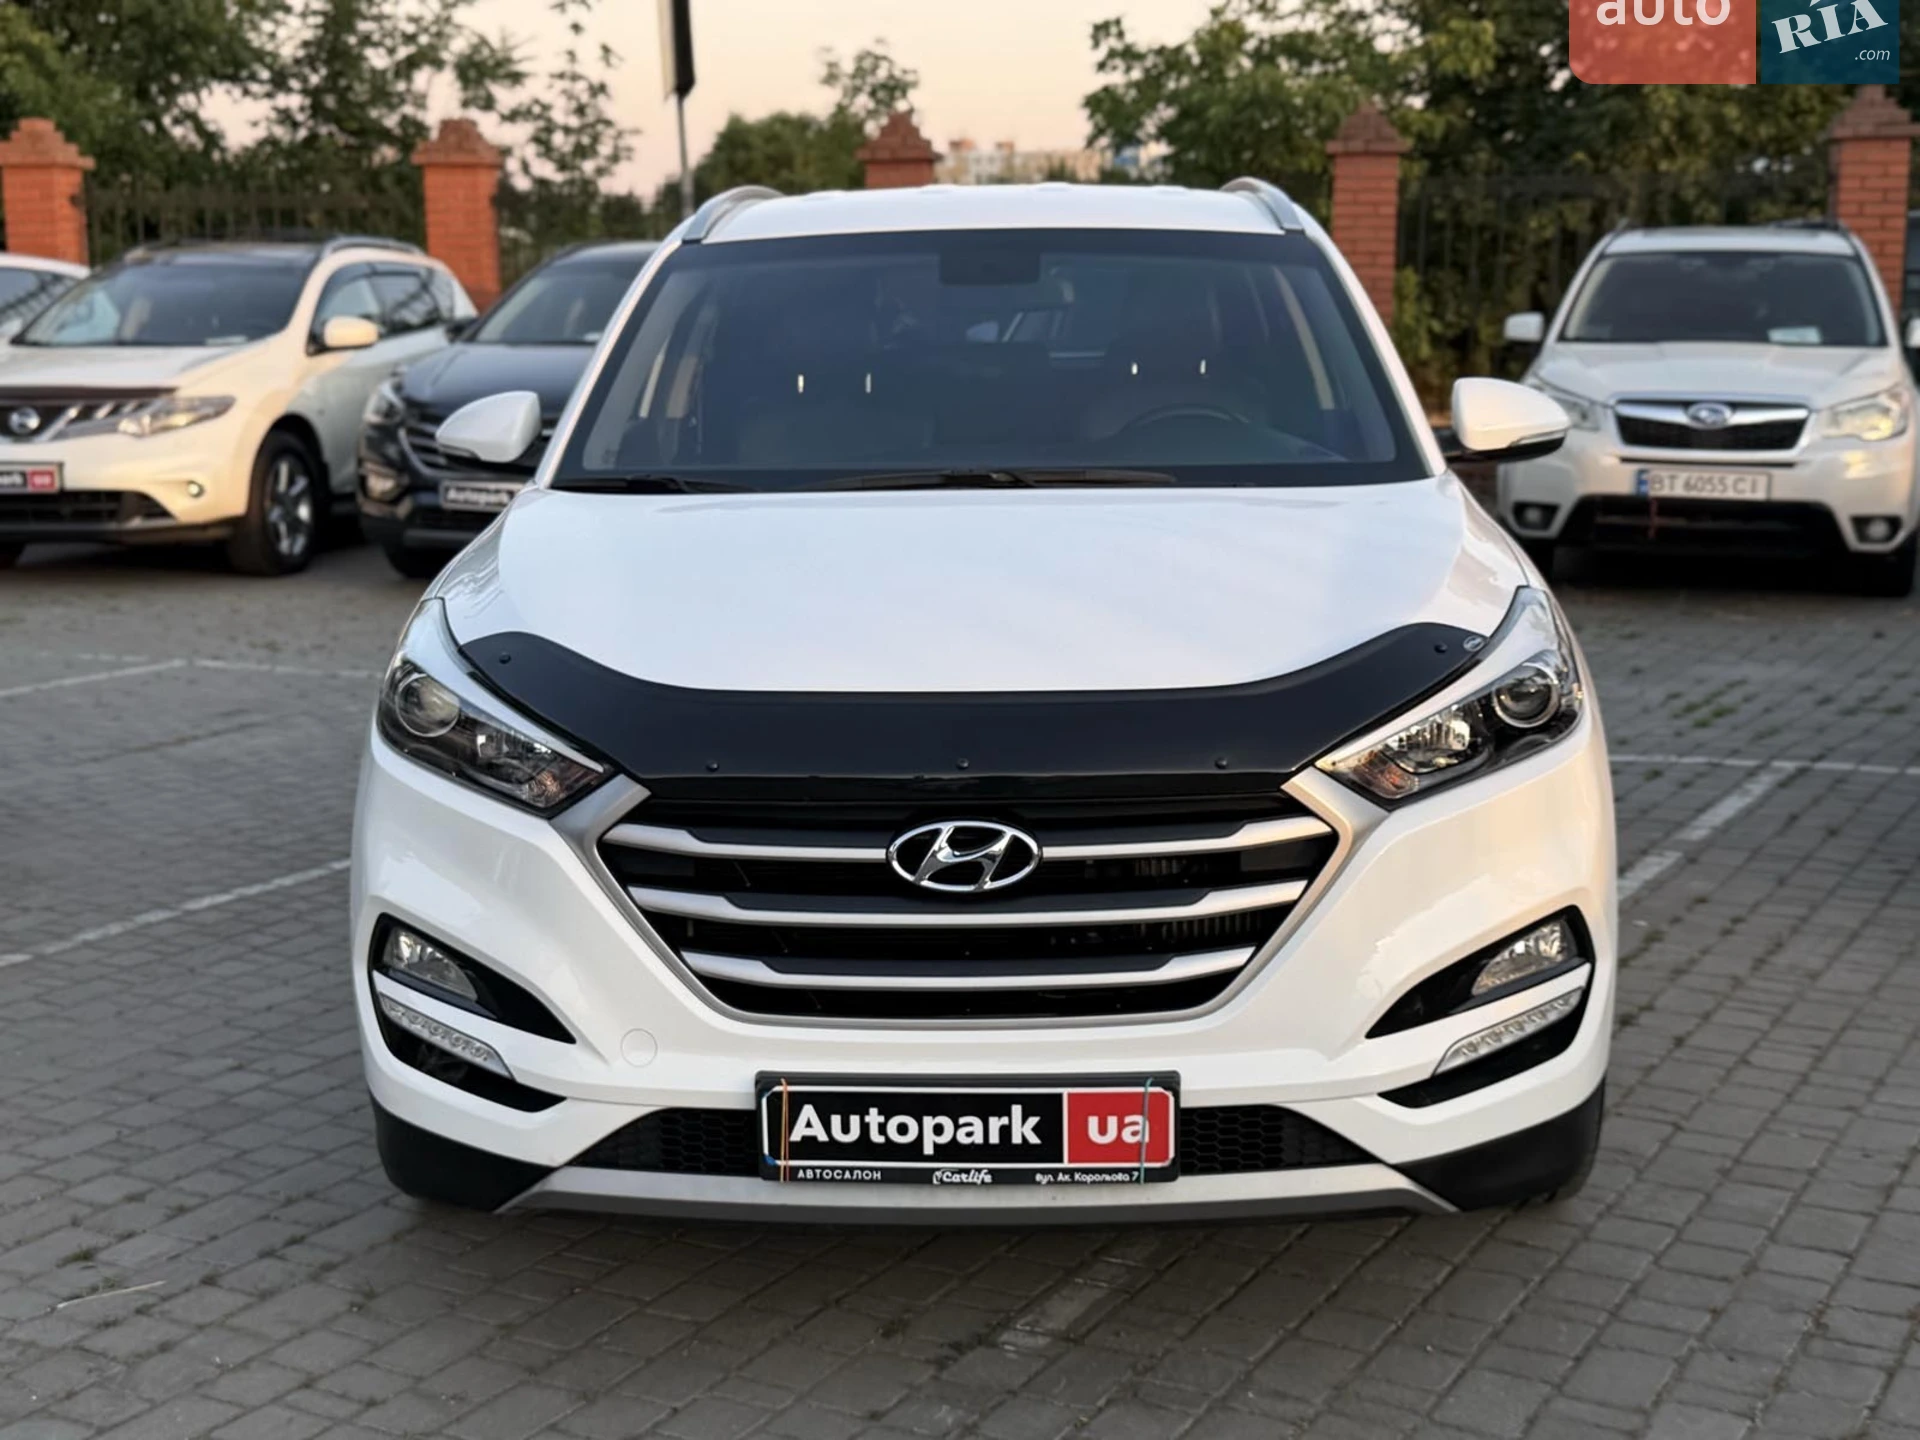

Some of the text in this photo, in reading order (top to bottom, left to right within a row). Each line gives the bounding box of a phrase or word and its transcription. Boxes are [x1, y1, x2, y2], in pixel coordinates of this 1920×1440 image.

[1683, 474, 1726, 494] 6055
[788, 1103, 1150, 1156] Autopark ua
[796, 1168, 882, 1181] АВТОСАЛОН
[1132, 1171, 1139, 1181] 7
